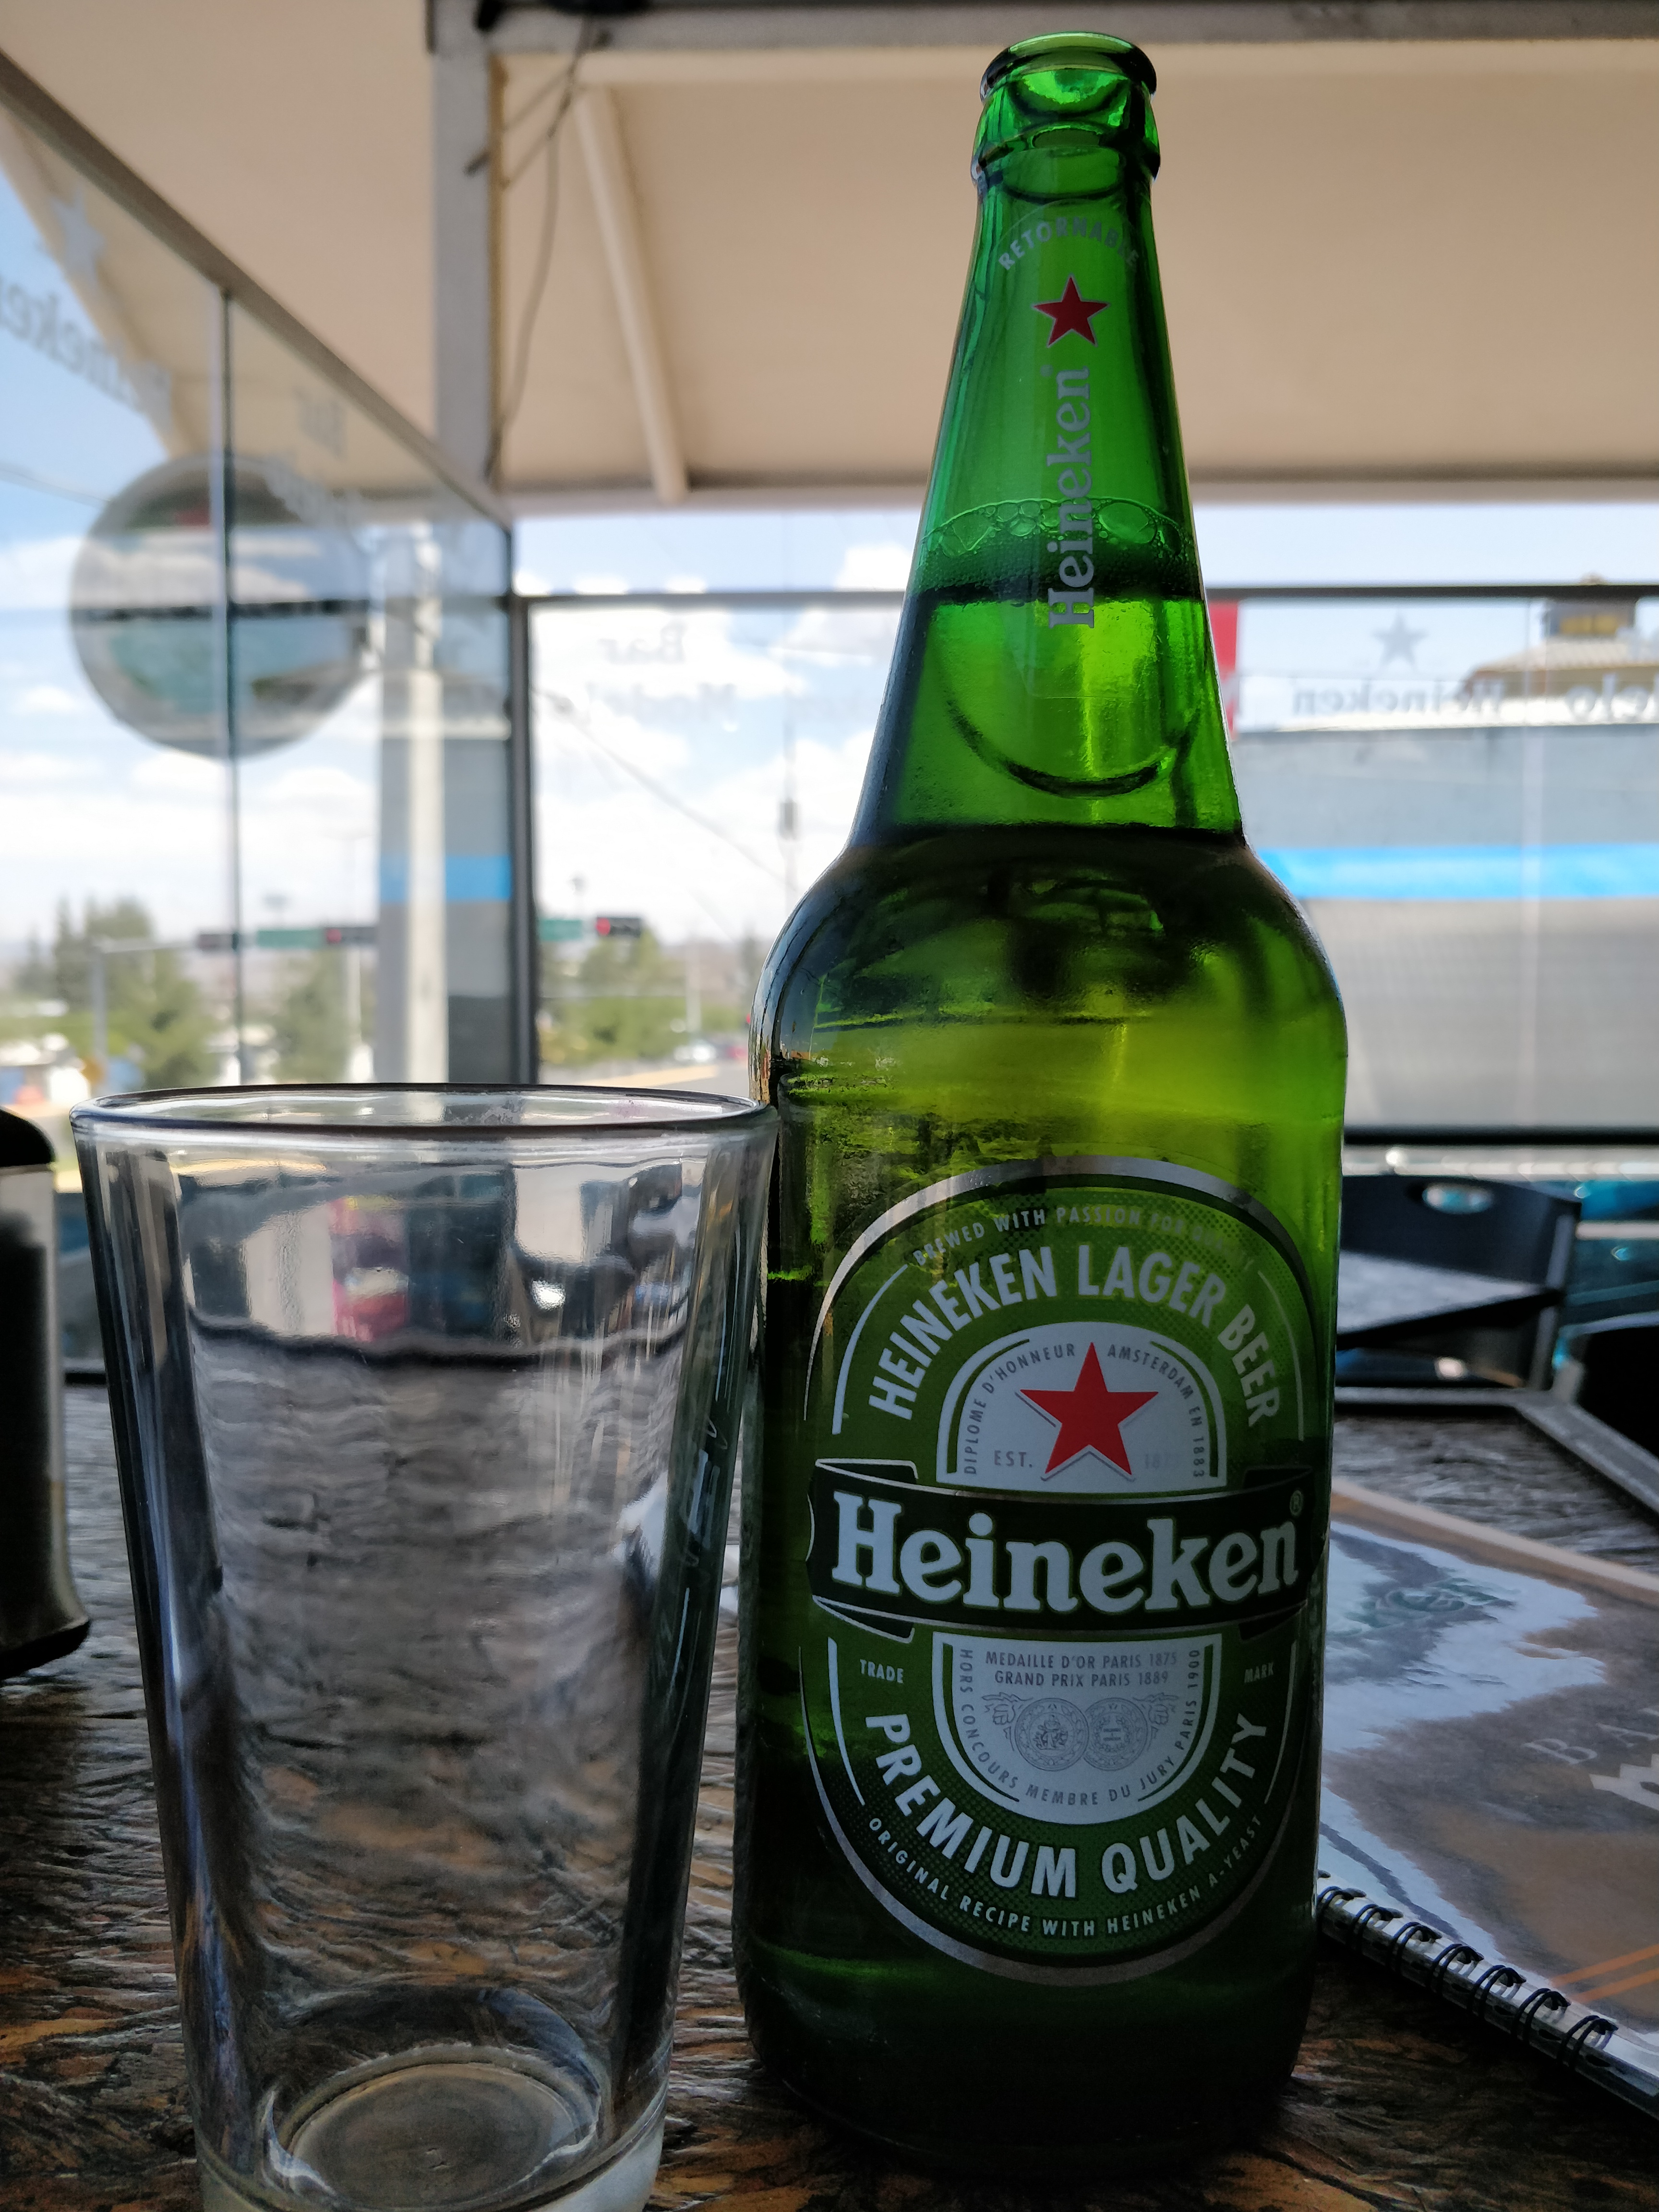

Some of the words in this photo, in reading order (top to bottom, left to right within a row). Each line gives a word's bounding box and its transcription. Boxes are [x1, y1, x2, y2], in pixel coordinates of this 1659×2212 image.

[1046, 366, 1094, 628] Heineken
[913, 1222, 985, 1266] BREWED
[994, 1209, 1045, 1232] WITH
[1056, 1206, 1141, 1225] PASSION
[1151, 1213, 1184, 1234] FOR
[868, 1246, 1057, 1420] HEINEKEN
[1077, 1245, 1227, 1328] LAGER
[1217, 1303, 1281, 1427] BEER
[982, 1343, 1076, 1394] D'HONNEUR
[1107, 1344, 1194, 1400] AMSTERDAM
[964, 1398, 987, 1475] DIPLOME
[1189, 1406, 1202, 1427] EN
[994, 1450, 1033, 1468] EST.
[1193, 1436, 1205, 1478] 1883
[860, 1659, 904, 1684] TRADE
[960, 1649, 973, 1693] HORS
[986, 1651, 1054, 1668] MEDAILLE
[1061, 1655, 1095, 1669] D'OR
[1103, 1654, 1141, 1669] PARIS
[1150, 1652, 1177, 1667] 1875
[995, 1670, 1045, 1686] GRAND
[1052, 1673, 1084, 1687] PRIX
[1091, 1672, 1130, 1687] PARIS
[1138, 1671, 1168, 1685] 1889
[1187, 1650, 1200, 1689] 1900
[1244, 1662, 1274, 1684] MARK
[962, 1704, 1018, 1789] CONCOURS
[1175, 1700, 1197, 1750] PARIS
[1520, 1705, 1659, 1765] BA
[1025, 1784, 1098, 1806] MEMBRE
[1108, 1784, 1131, 1802] DU
[1139, 1755, 1175, 1791] JURY
[866, 1713, 1076, 1898] PREMIUM
[1101, 1712, 1268, 1894] QUALITY
[869, 1817, 950, 1901] ORIGINAL
[960, 1895, 1030, 1932] RECIPE
[1042, 1919, 1094, 1936] WITH
[1107, 1885, 1201, 1934] HEINEKEN
[1208, 1814, 1261, 1887] A-YEAST
